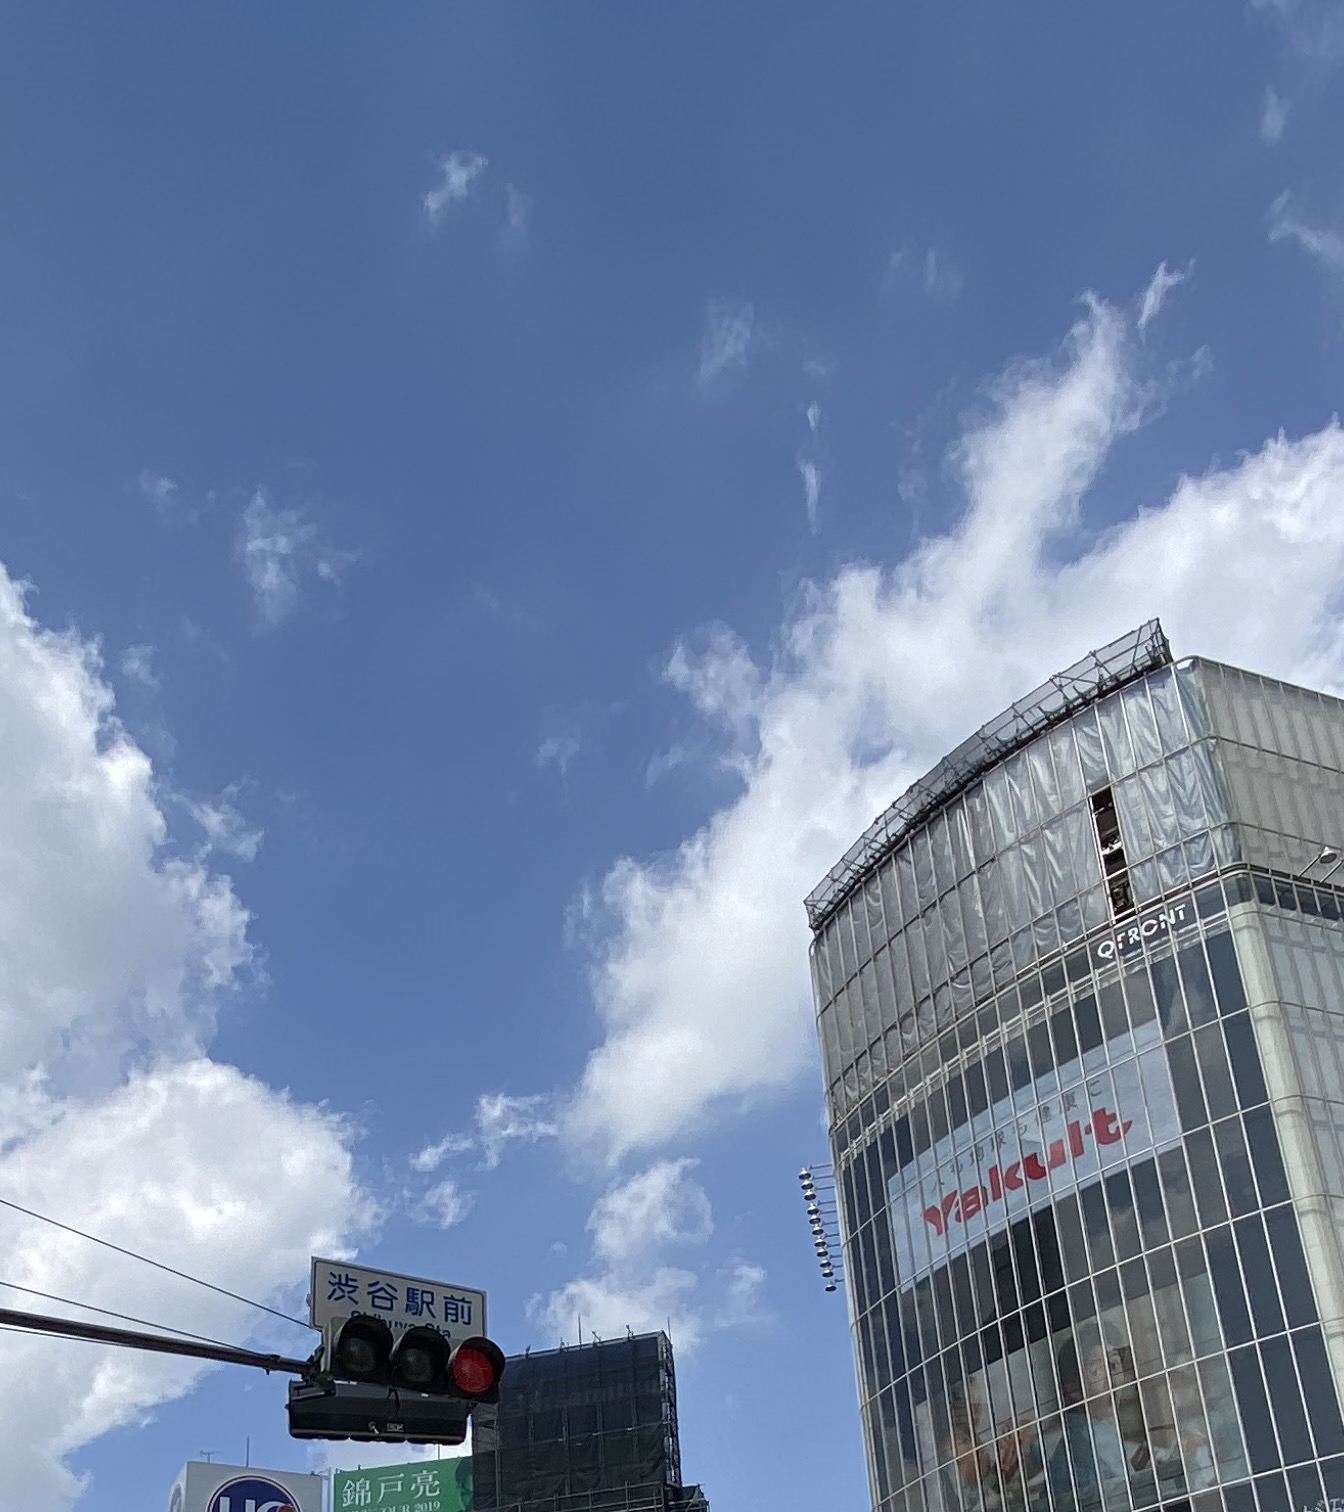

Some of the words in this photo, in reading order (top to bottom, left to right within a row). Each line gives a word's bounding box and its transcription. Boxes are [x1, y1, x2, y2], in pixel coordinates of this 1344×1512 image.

[1098, 904, 1187, 959] QFRONT
[922, 1107, 1133, 1236] Yakult
[327, 1272, 473, 1326] 渋谷駅前
[343, 1470, 440, 1508] 錦戸亮
